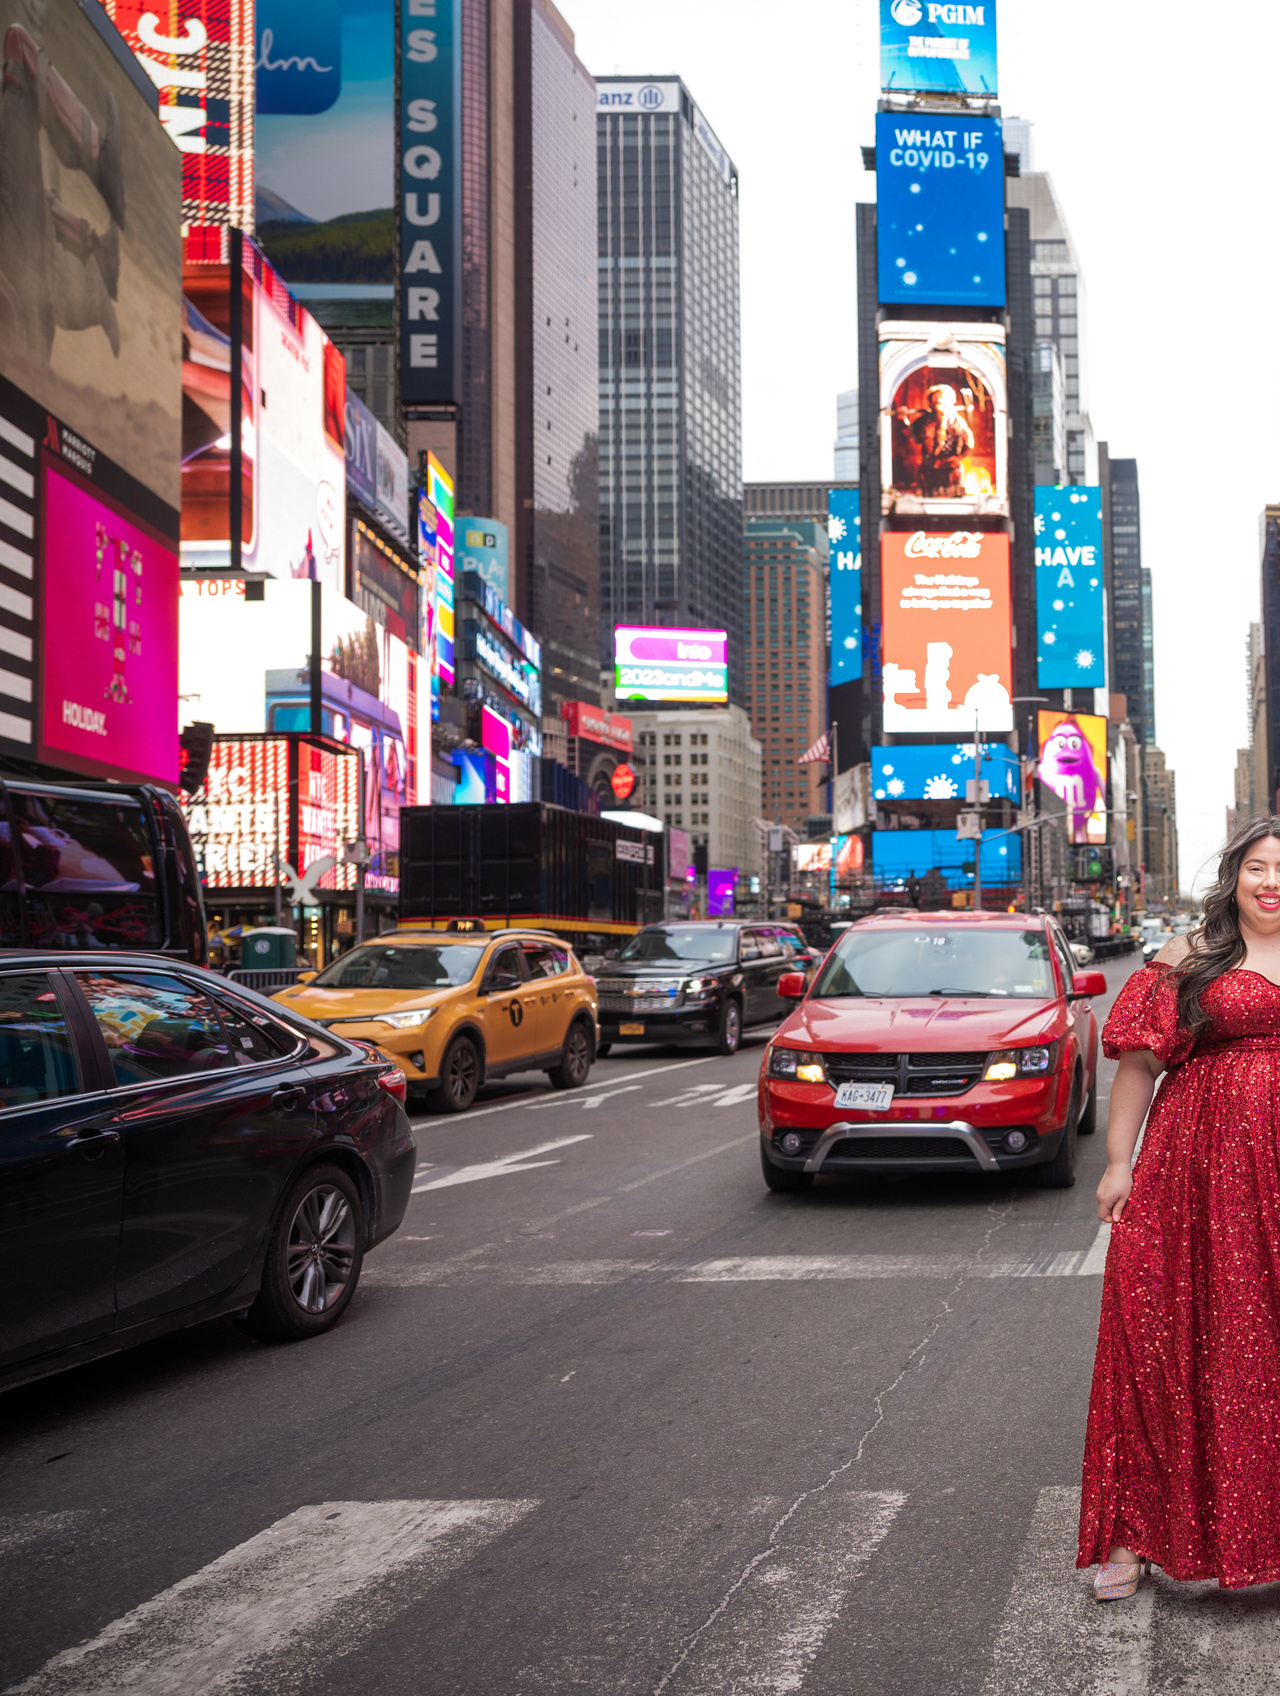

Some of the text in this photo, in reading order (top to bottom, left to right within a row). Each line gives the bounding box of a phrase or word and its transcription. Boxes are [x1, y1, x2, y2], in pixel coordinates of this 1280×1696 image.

[927, 3, 985, 25] PGIM
[894, 129, 983, 149] WHAT IF
[890, 149, 989, 169] COVID-19
[403, 99, 443, 368] SQUARE
[1034, 546, 1096, 567] HAVE
[1057, 567, 1075, 588] A
